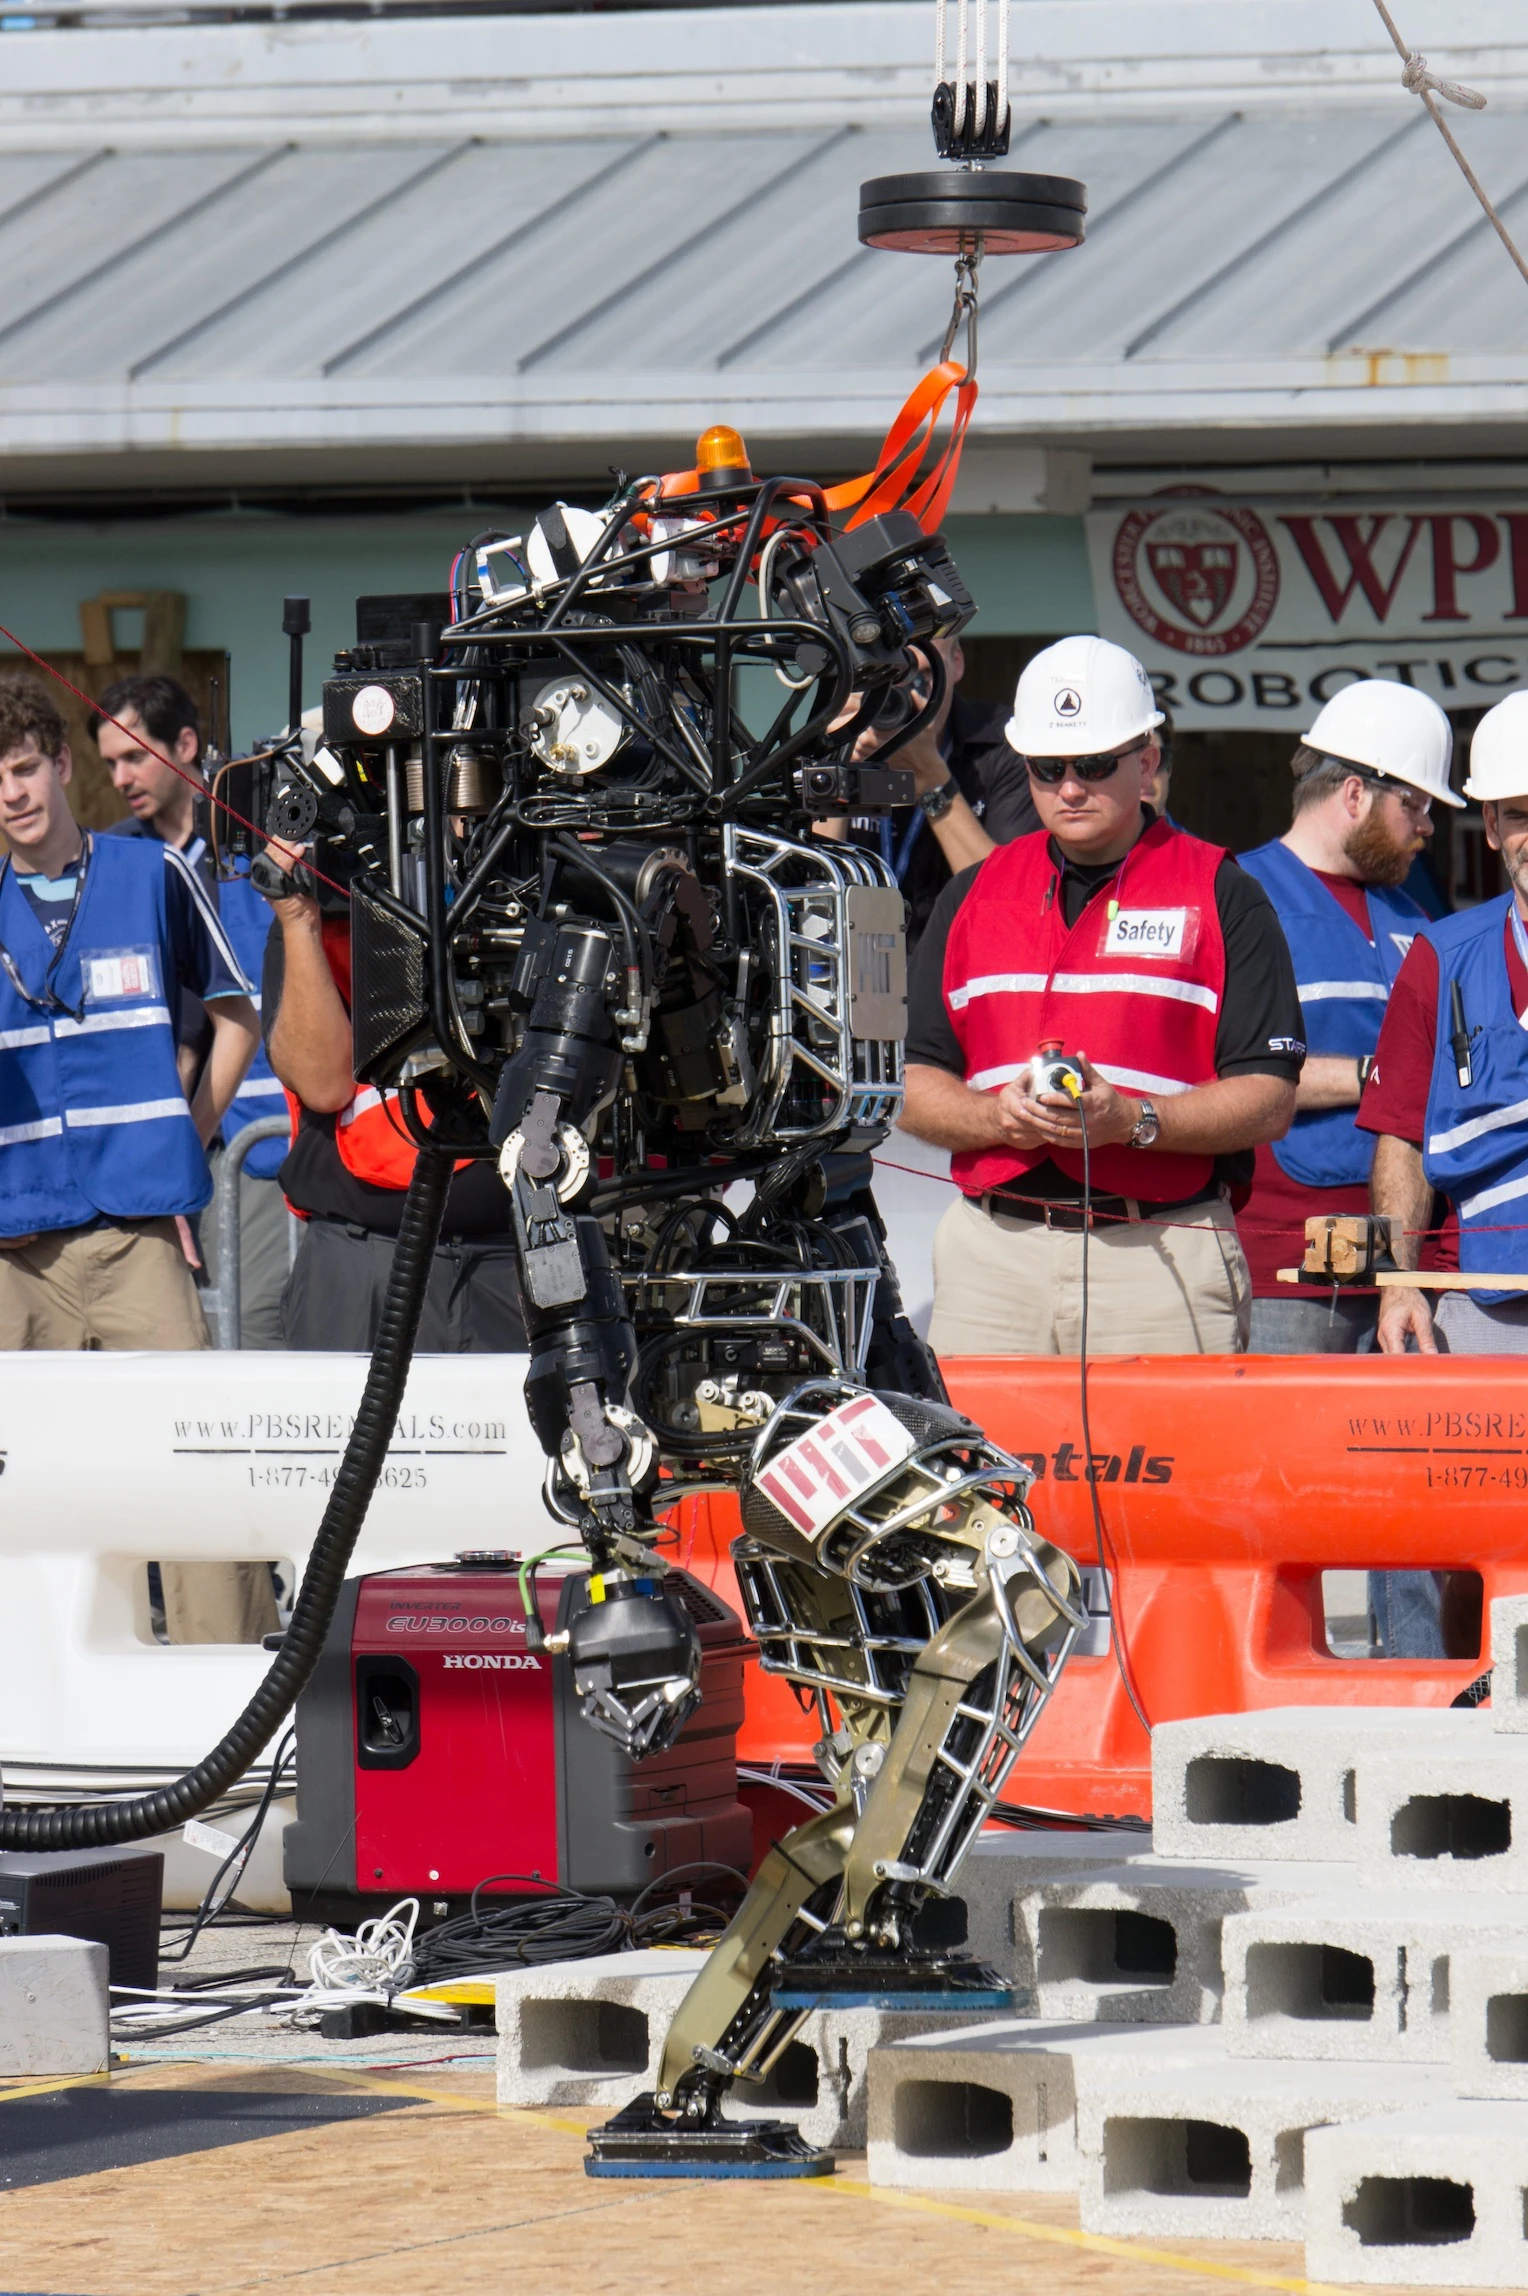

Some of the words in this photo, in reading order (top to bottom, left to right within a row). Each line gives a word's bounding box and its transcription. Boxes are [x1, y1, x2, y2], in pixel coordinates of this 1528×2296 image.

[1275, 511, 1528, 625] WPI
[1116, 920, 1176, 947] Safety
[174, 1413, 507, 1439] www.PBSREALS.com
[389, 1601, 462, 1611] INVERTER
[385, 1616, 527, 1634] EU3000is
[443, 1654, 543, 1670] HONDA
